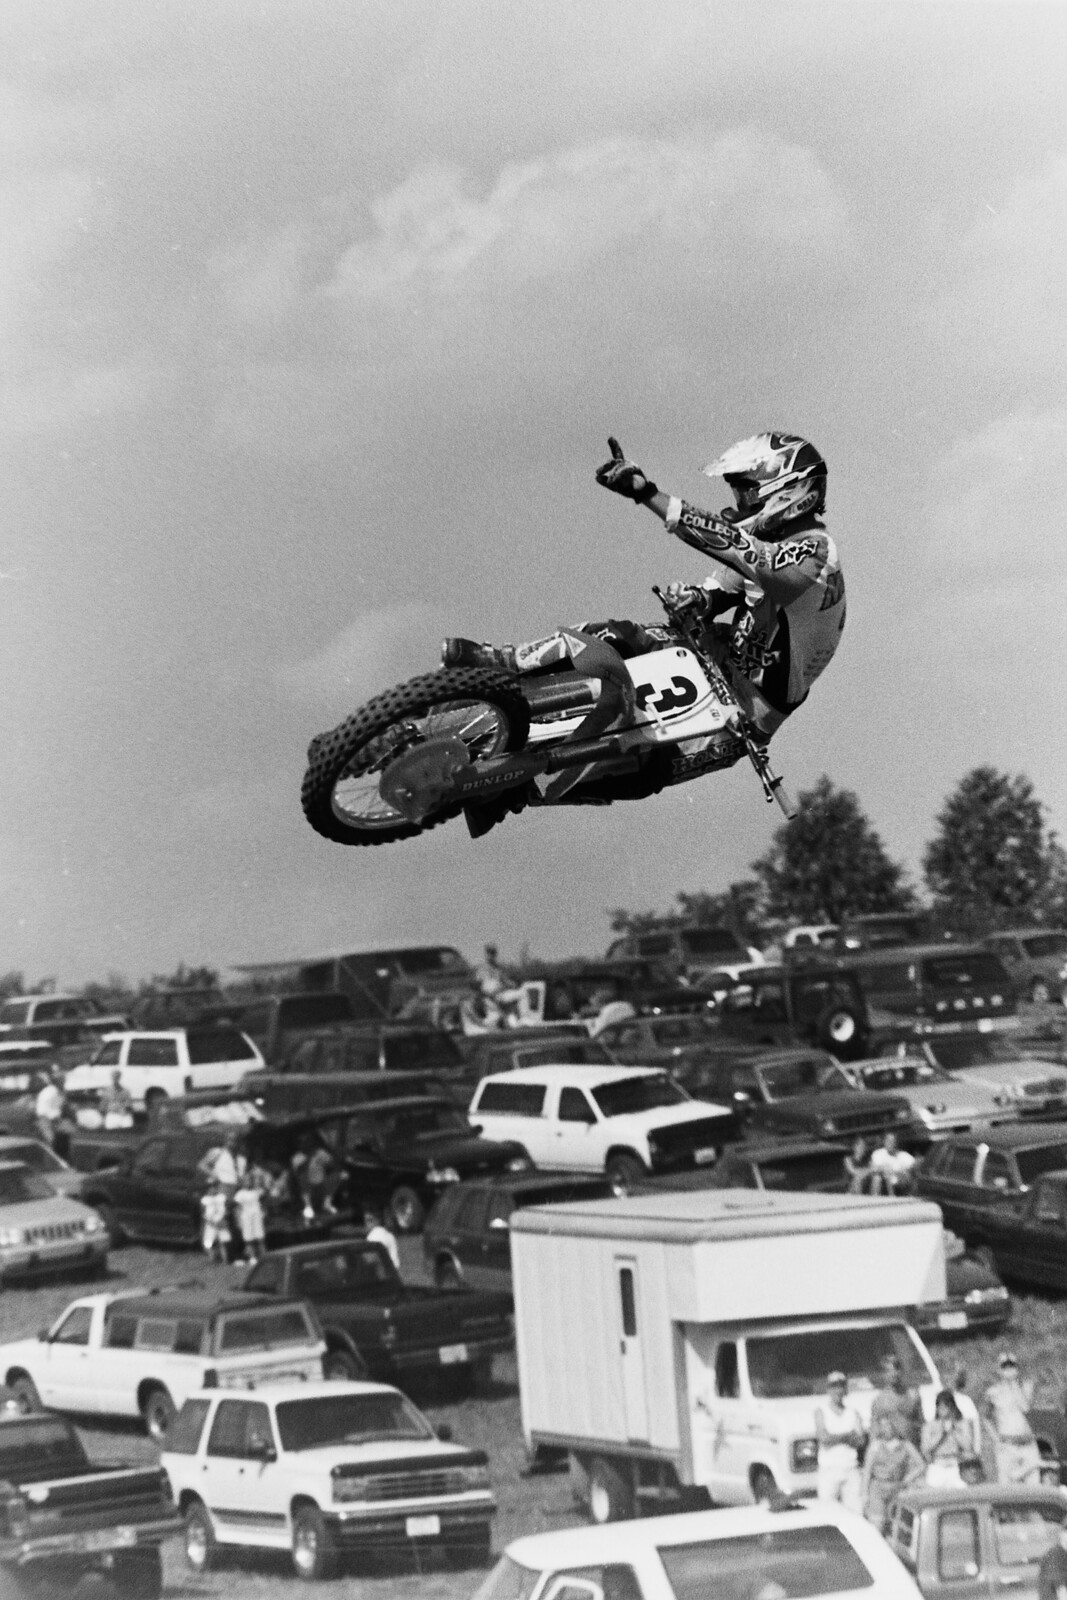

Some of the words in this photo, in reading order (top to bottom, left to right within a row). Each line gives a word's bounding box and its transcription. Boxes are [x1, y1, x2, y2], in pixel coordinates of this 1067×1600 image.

[683, 513, 738, 539] COLLECT
[636, 676, 698, 713] 3
[462, 770, 524, 791] DUNLOP
